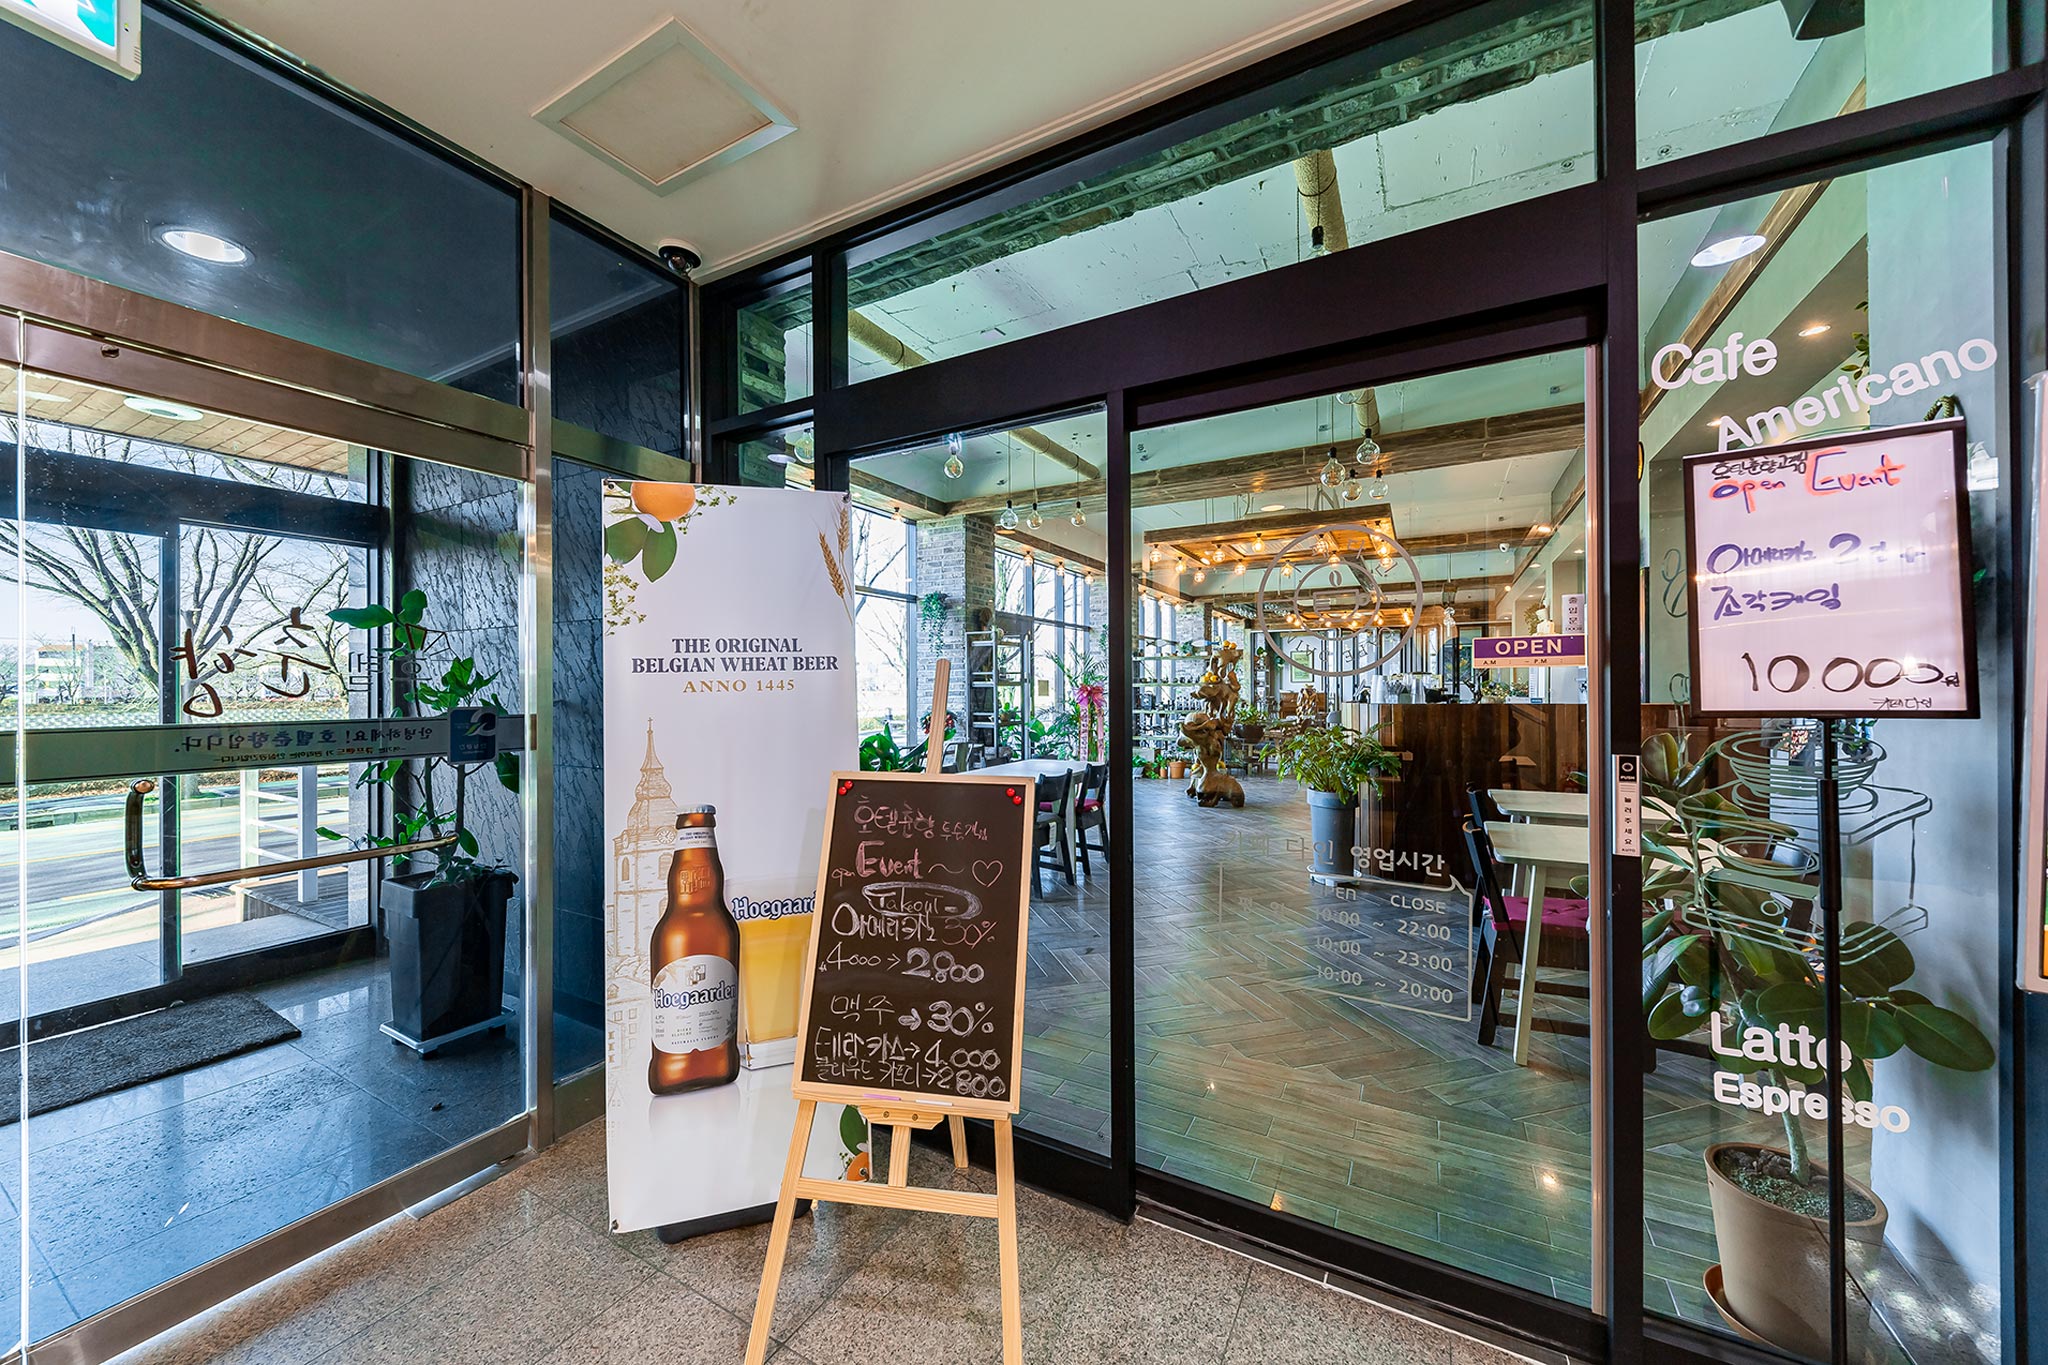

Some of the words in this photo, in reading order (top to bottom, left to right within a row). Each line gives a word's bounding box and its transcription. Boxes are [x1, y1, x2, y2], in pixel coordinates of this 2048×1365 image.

[1651, 331, 1778, 390] Cafe
[1716, 338, 1998, 451] Americano
[1807, 447, 1905, 496] Event
[672, 637, 710, 654] THE
[715, 637, 802, 654] ORIGINAL
[1494, 638, 1562, 655] OPEN
[631, 657, 715, 674] BELGIAN
[720, 656, 788, 672] WHEAT
[793, 655, 839, 671] BEER
[683, 680, 747, 693] ANNO
[757, 679, 795, 692] 1445
[855, 840, 924, 880] Event
[1350, 845, 1445, 877] 영업시간
[732, 890, 816, 920] Hoegaard
[1390, 894, 1447, 914] CLOSE
[1398, 919, 1451, 941] 22:00
[1398, 950, 1452, 972] 23:00
[653, 982, 737, 1010] Hoegaarden
[1399, 979, 1453, 1004] 20:00
[927, 1000, 995, 1038] 30%
[1709, 1011, 1852, 1073] Latte
